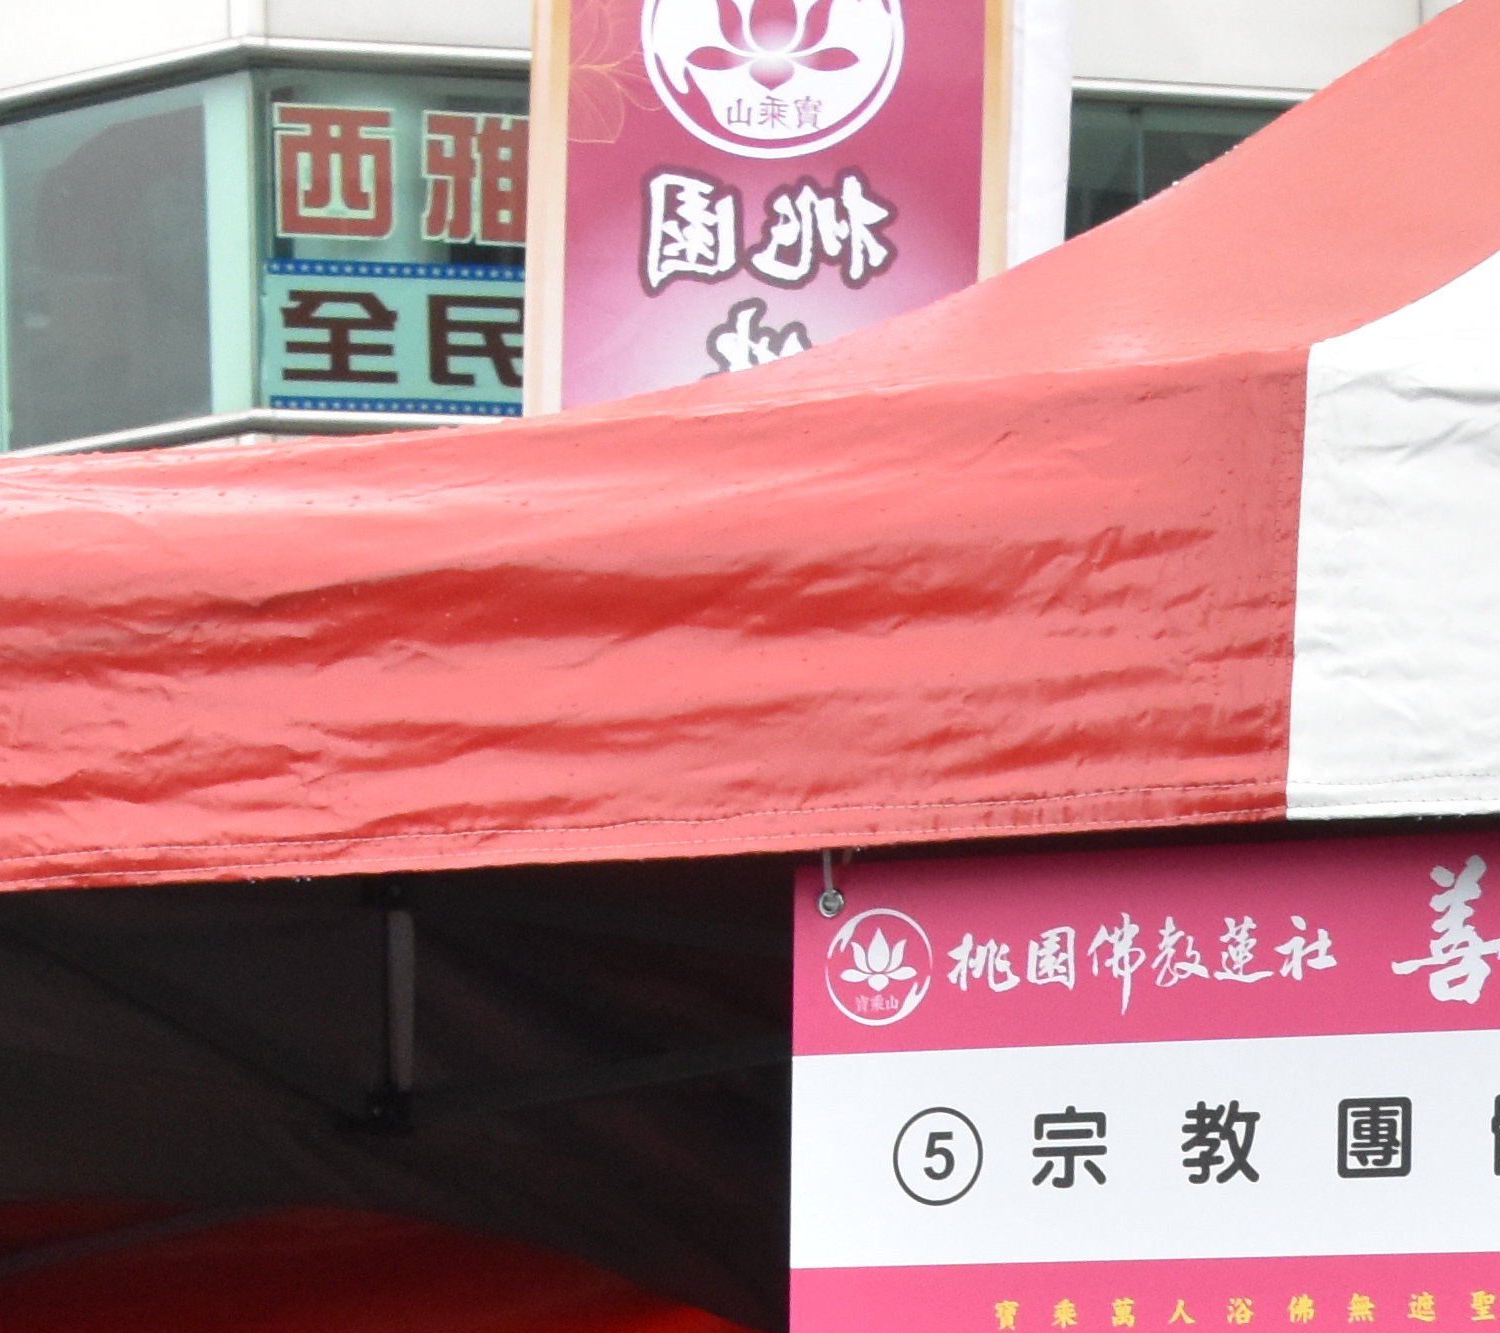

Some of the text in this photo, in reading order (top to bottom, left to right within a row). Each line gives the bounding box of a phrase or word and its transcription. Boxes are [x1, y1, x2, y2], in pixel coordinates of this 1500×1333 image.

[279, 289, 526, 389] 全民
[947, 912, 1338, 1015] 桃園佛教蓮社
